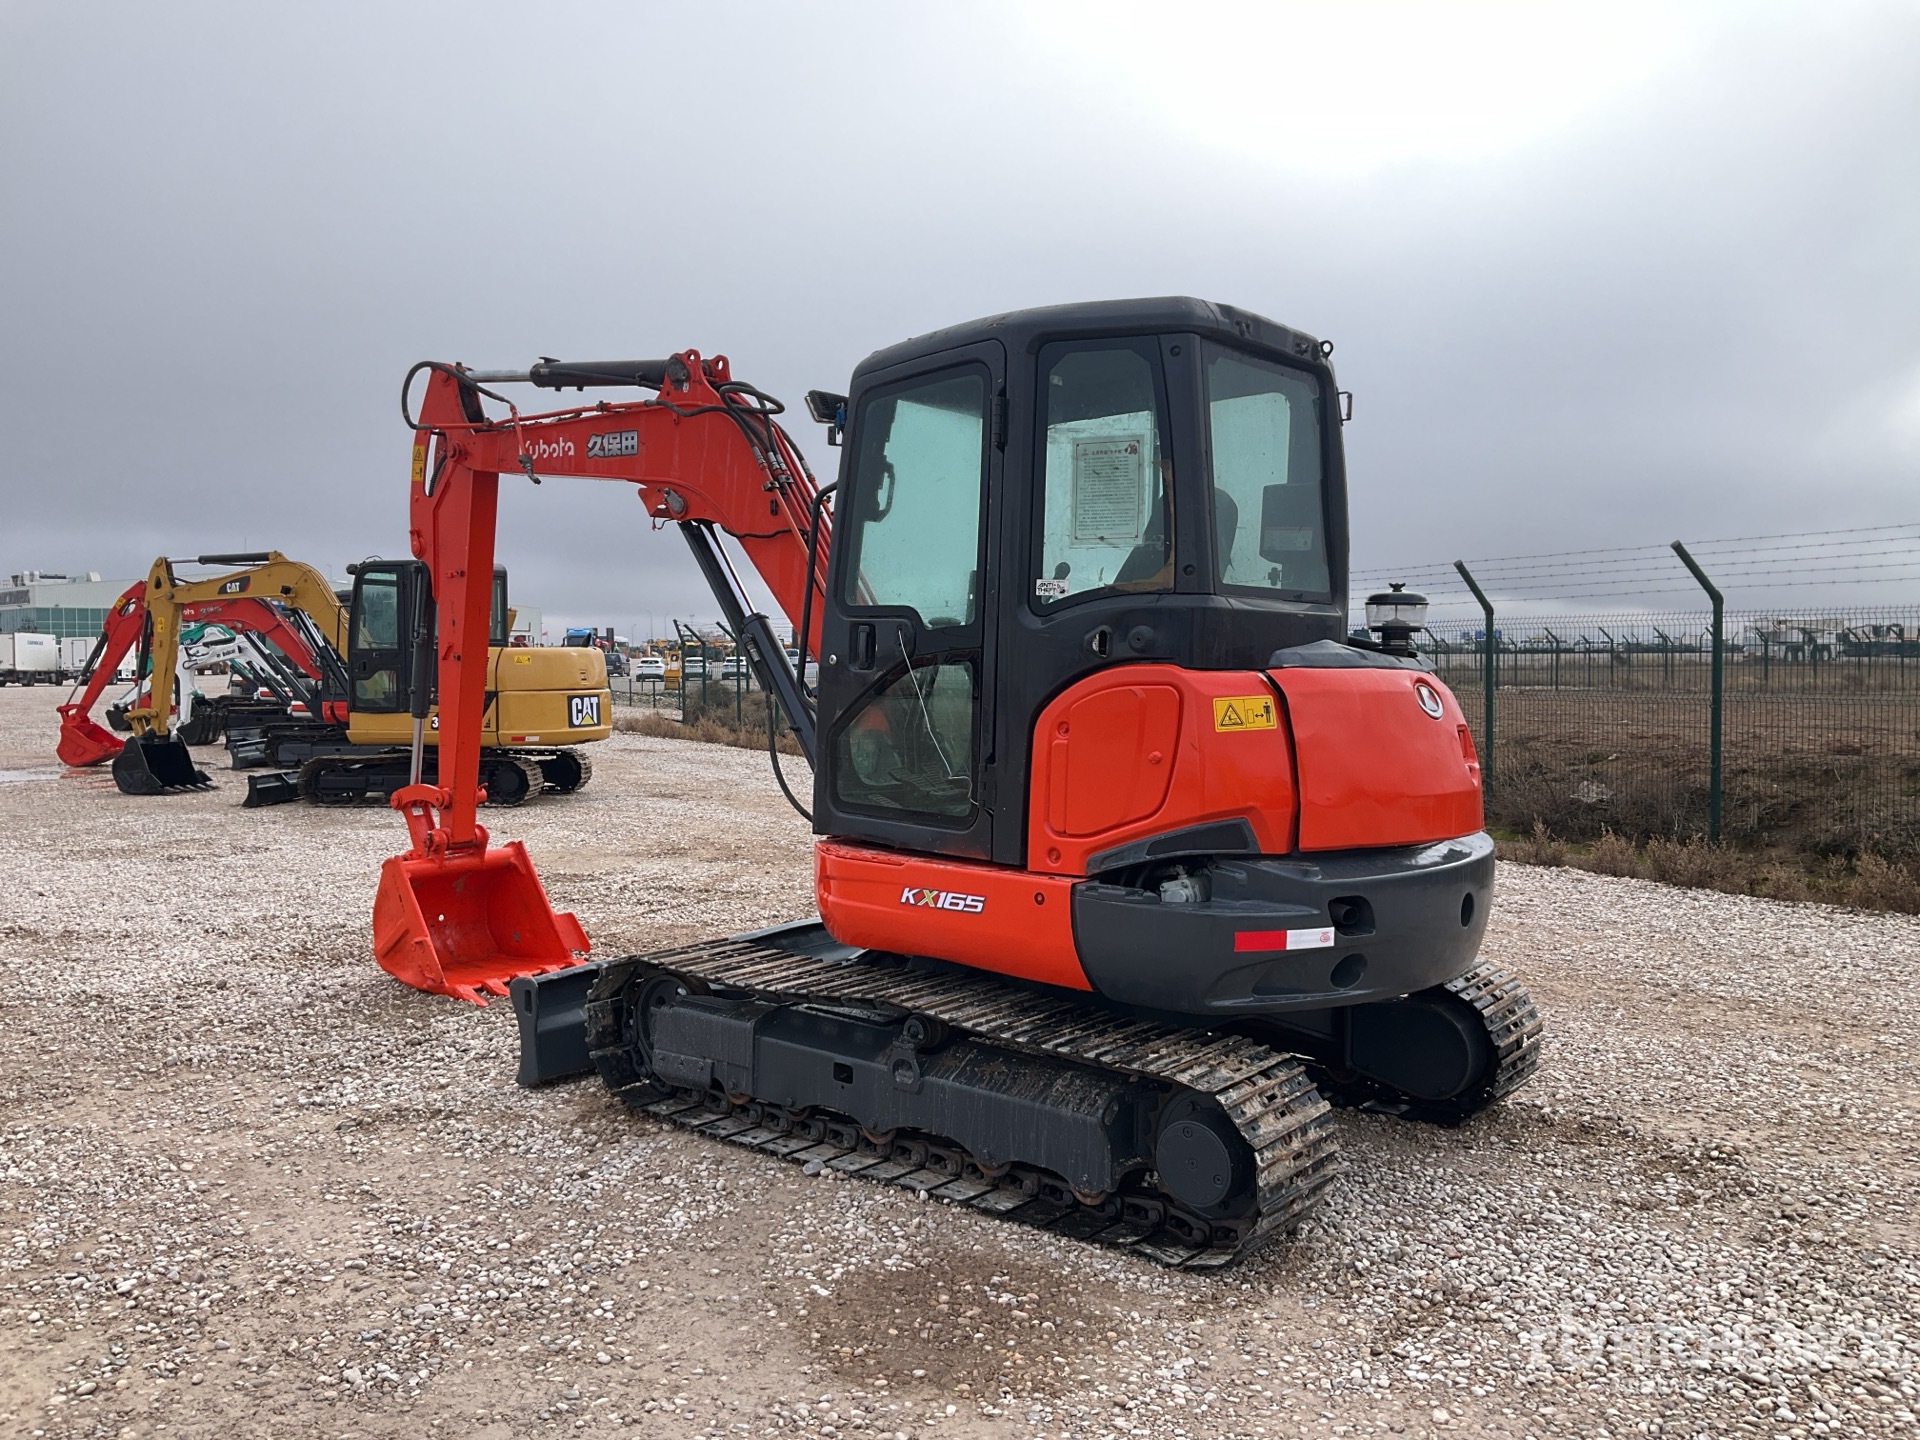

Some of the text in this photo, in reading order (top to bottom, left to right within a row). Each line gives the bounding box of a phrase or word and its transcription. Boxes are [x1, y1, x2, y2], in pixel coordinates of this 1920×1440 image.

[586, 430, 639, 458] 久保田
[226, 582, 240, 593] CAT
[431, 716, 439, 728] 3
[571, 696, 599, 726] CAT
[900, 887, 986, 914] KX165
